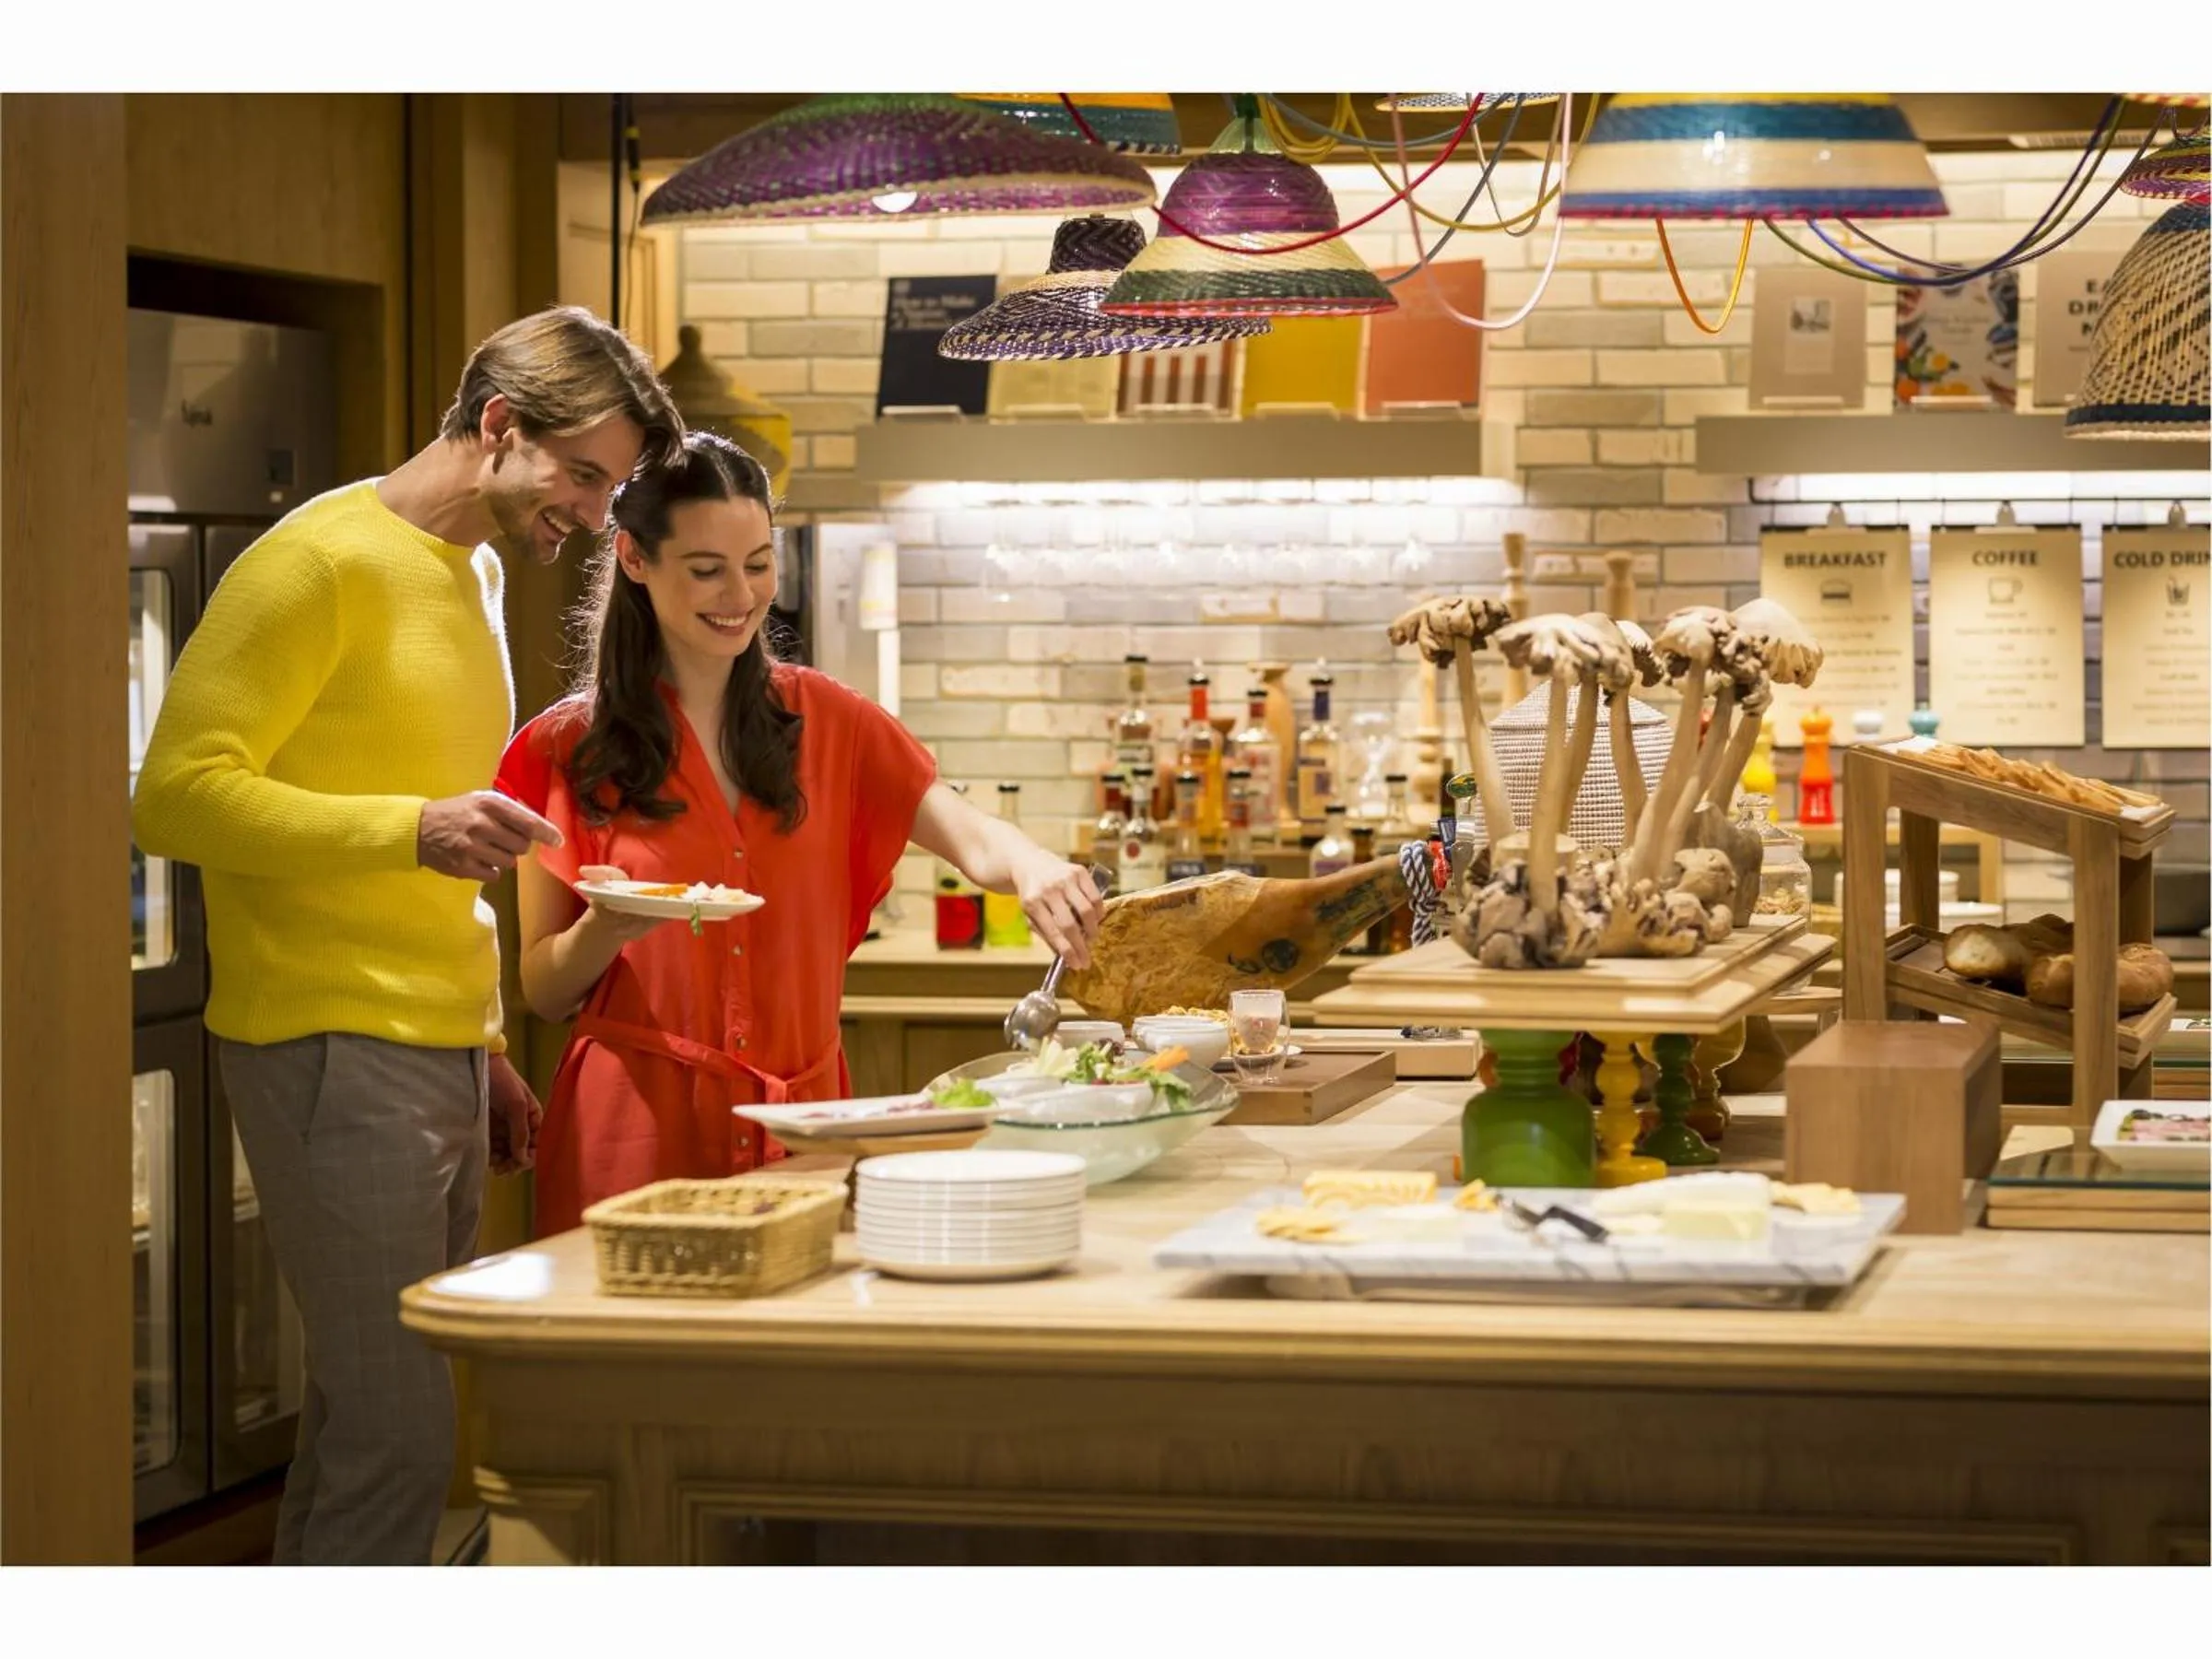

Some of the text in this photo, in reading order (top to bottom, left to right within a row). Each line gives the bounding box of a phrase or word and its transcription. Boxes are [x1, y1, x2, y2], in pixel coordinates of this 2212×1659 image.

[1783, 551, 1887, 568] BREAKFAST
[1971, 549, 2039, 567] COFFEE
[2113, 550, 2164, 568] COLD
